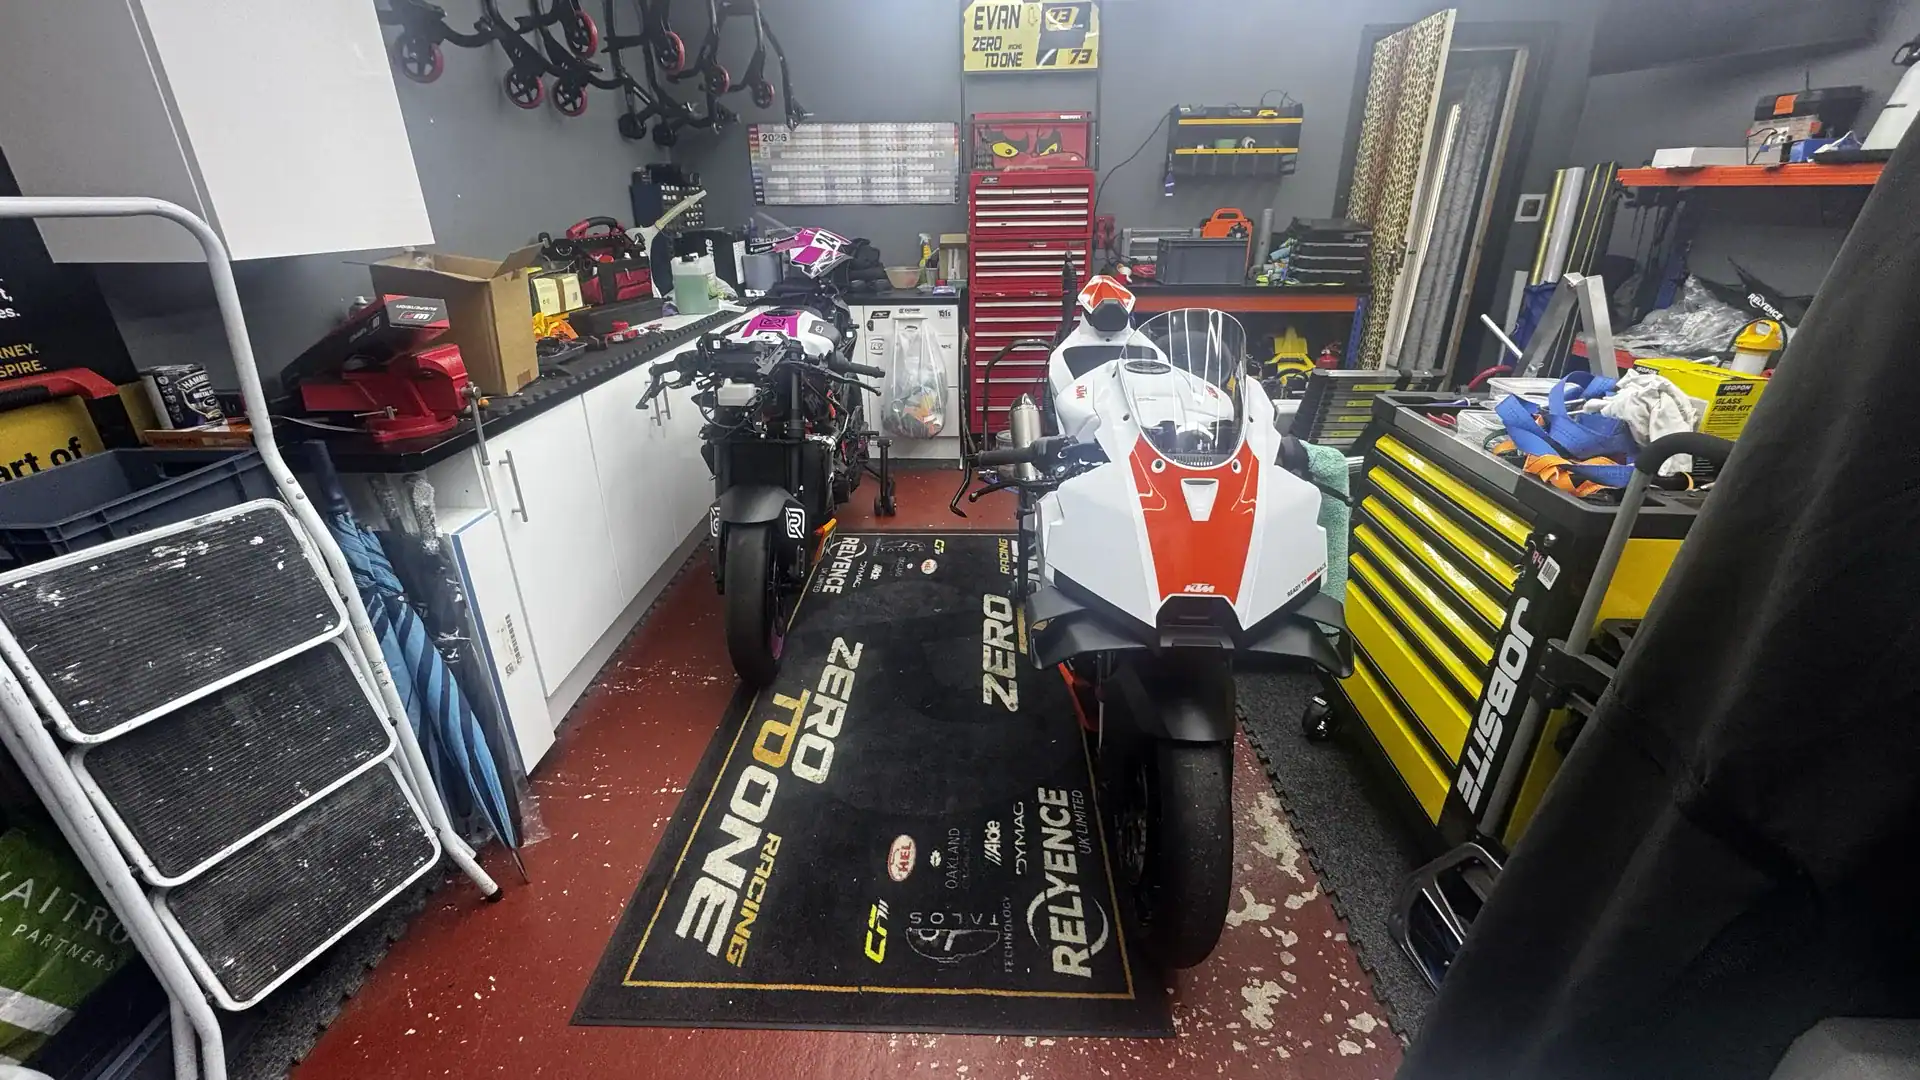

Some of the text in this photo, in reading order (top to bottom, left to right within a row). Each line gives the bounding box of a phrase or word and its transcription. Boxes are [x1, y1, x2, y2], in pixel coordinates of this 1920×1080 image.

[973, 5, 1022, 31] EVAN
[972, 36, 1002, 51] ZERO
[1069, 49, 1093, 65] 73
[762, 133, 787, 142] 2026
[1747, 293, 1784, 321] RELYENCE
[1075, 385, 1087, 399] KTM
[50, 436, 82, 466] of
[822, 537, 860, 594] RELYENCE
[999, 538, 1011, 574] RACING
[1183, 583, 1215, 593] KTM
[1286, 585, 1301, 597] READY
[982, 593, 1019, 712] ZERO
[790, 636, 864, 785] ZERO
[1456, 596, 1534, 815] JOBSITE
[675, 689, 811, 957] TO ONE
[1070, 789, 1089, 836] LIMITED
[896, 840, 912, 873] HEL
[945, 827, 961, 890] OAKLAND
[725, 831, 783, 968] RACING
[1037, 787, 1092, 979] RELYENCE
[0, 870, 131, 944] AITRO
[909, 911, 1000, 927] TALOS
[11, 924, 117, 973] PARTNERS
[1000, 895, 1013, 974] TECHNOLOGY
